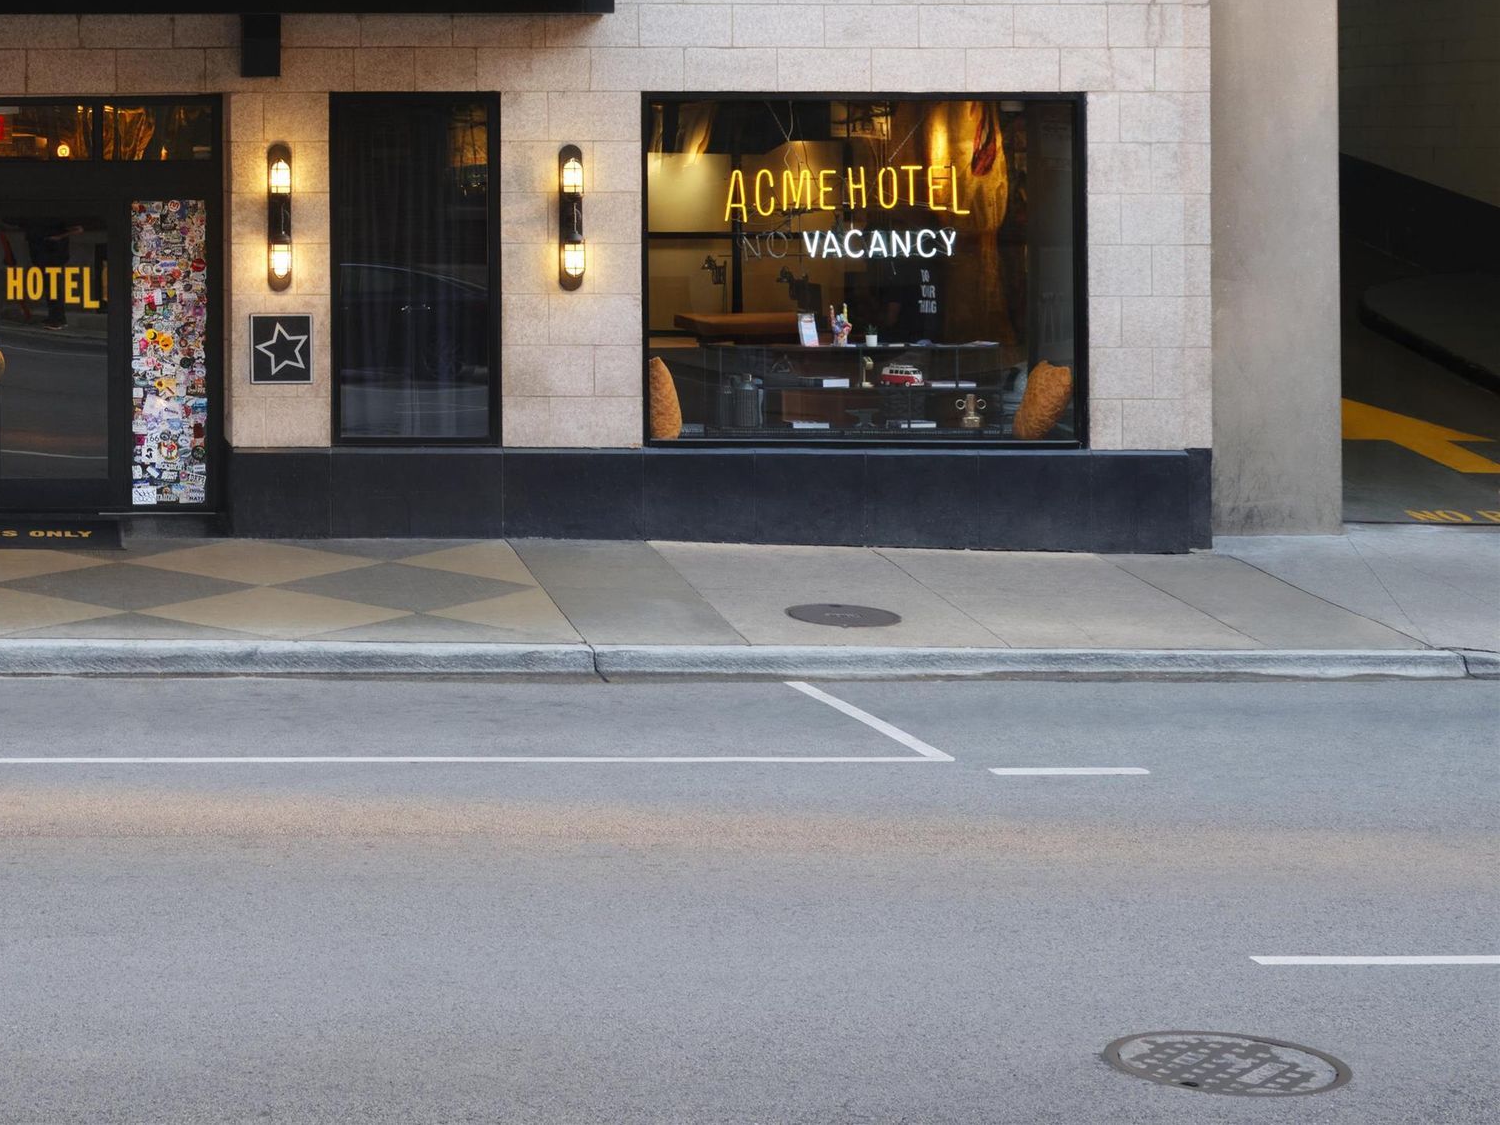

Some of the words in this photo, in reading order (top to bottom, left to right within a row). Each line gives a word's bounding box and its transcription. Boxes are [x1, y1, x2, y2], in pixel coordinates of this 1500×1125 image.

[724, 169, 837, 223] ACME
[847, 165, 971, 215] HOTEL
[741, 231, 789, 261] NO
[802, 228, 957, 258] VACANCY
[6, 266, 100, 309] HOTEL
[28, 530, 93, 538] ONLY
